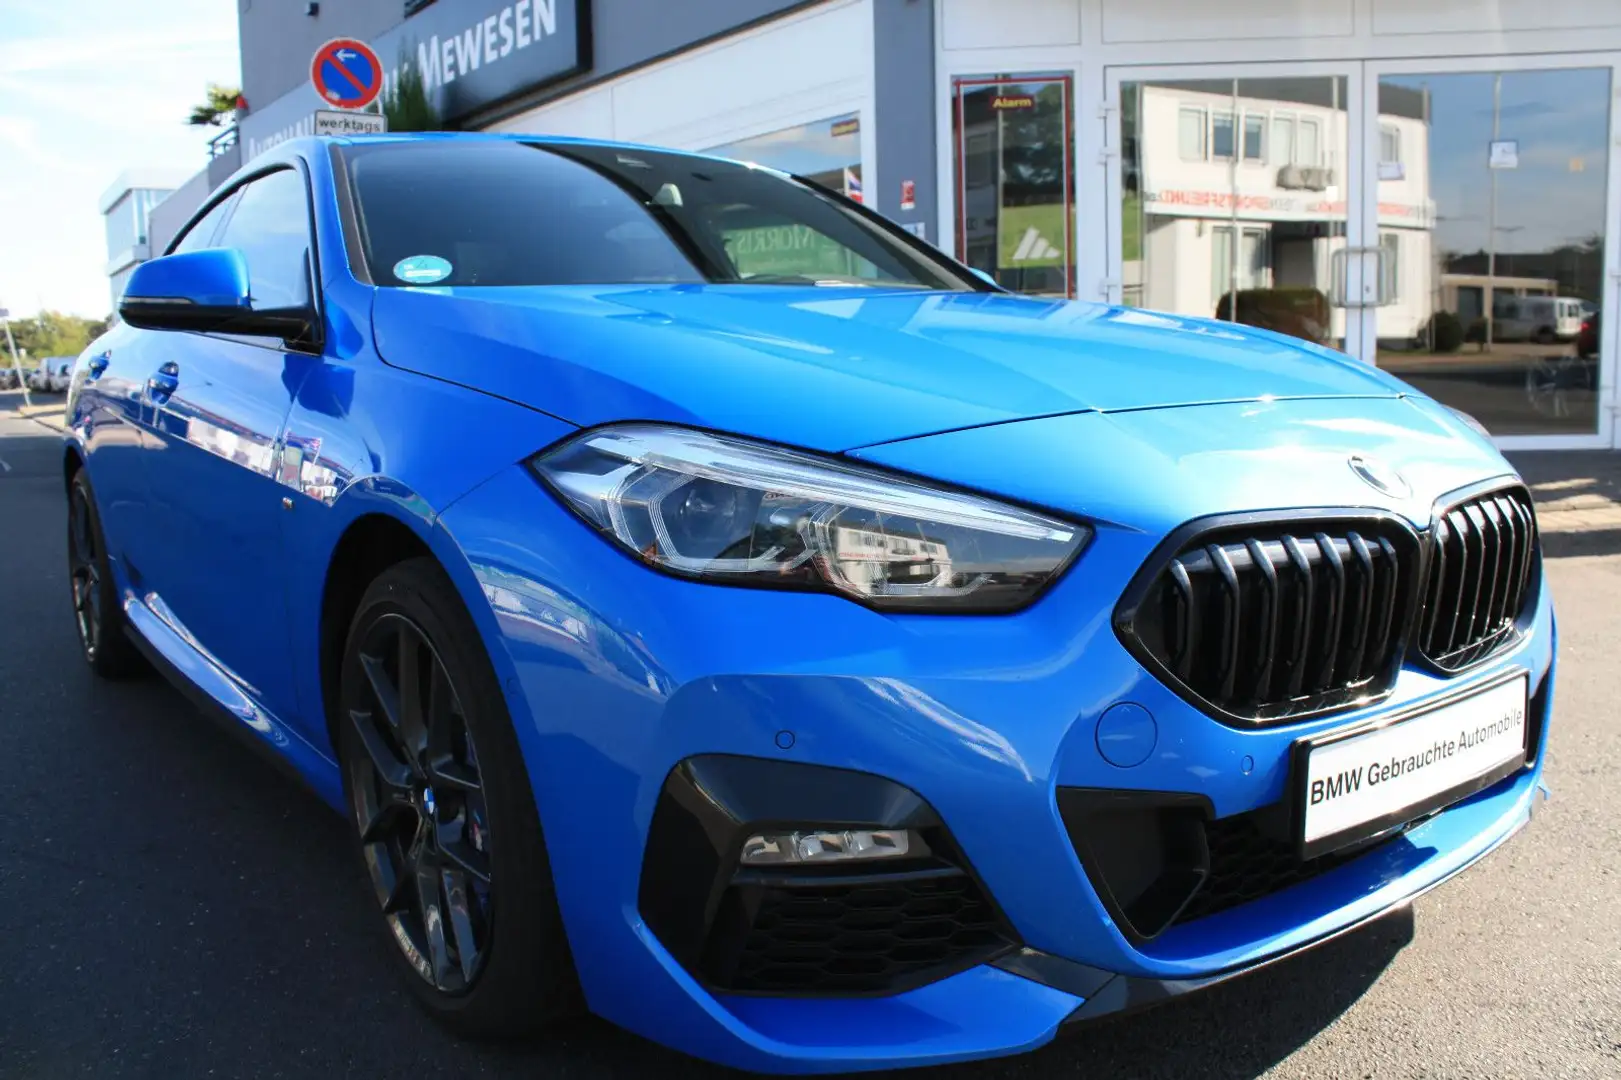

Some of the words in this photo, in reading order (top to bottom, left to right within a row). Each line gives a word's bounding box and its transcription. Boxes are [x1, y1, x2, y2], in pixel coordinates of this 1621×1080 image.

[248, 114, 316, 161] AUTOHAU
[418, 0, 557, 91] MEWESEN
[992, 97, 1033, 109] Alarm
[318, 117, 381, 133] werktags
[1310, 766, 1363, 805] BMW
[1367, 739, 1455, 787] Gebrauchte
[1458, 709, 1523, 750] Automobile
